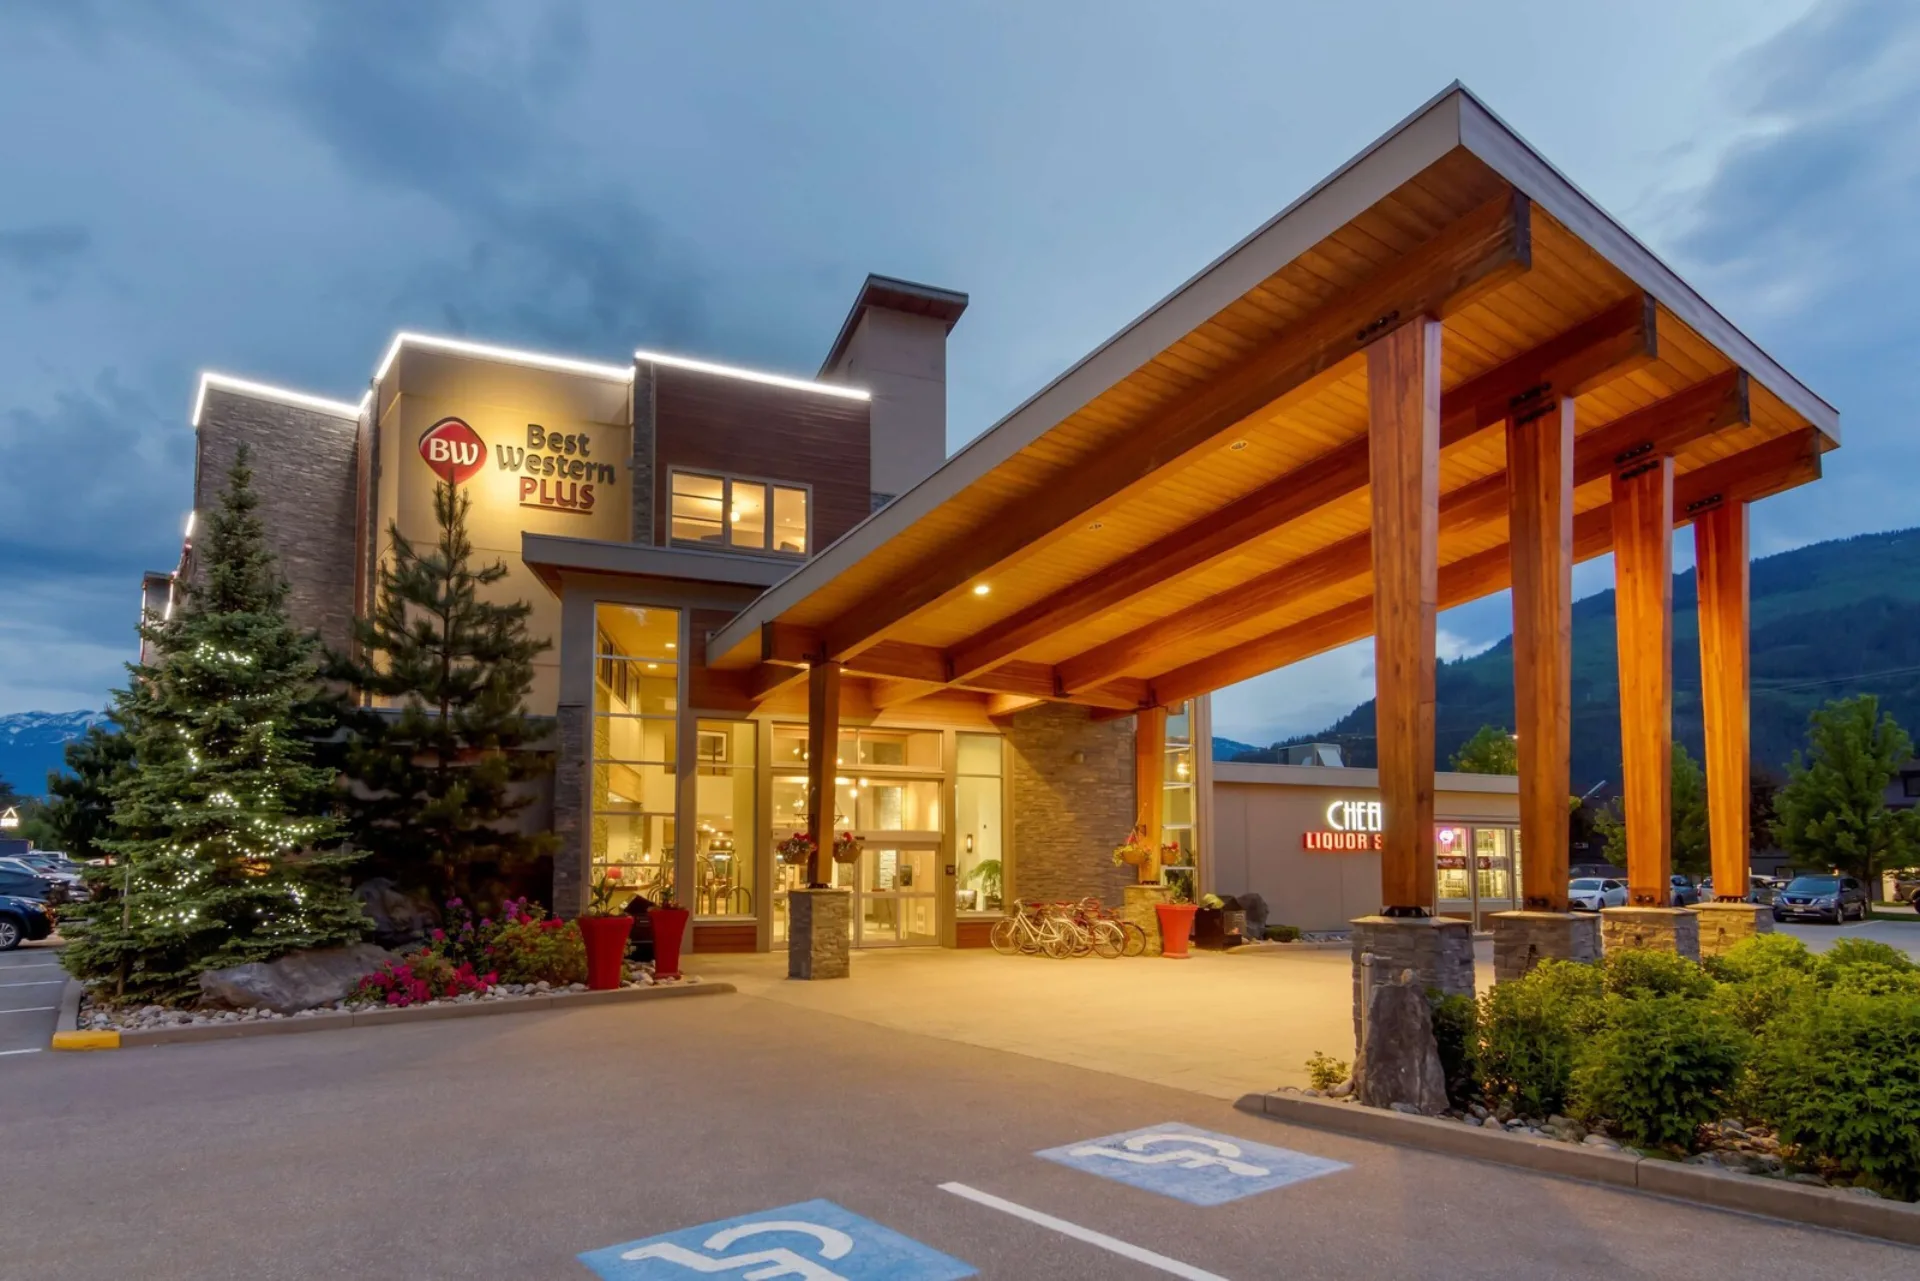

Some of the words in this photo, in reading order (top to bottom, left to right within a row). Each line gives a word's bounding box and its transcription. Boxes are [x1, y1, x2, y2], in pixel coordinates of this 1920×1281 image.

[429, 437, 479, 466] BW
[527, 424, 590, 457] Best
[496, 444, 616, 485] Western
[1304, 832, 1368, 850] LIQUOR
